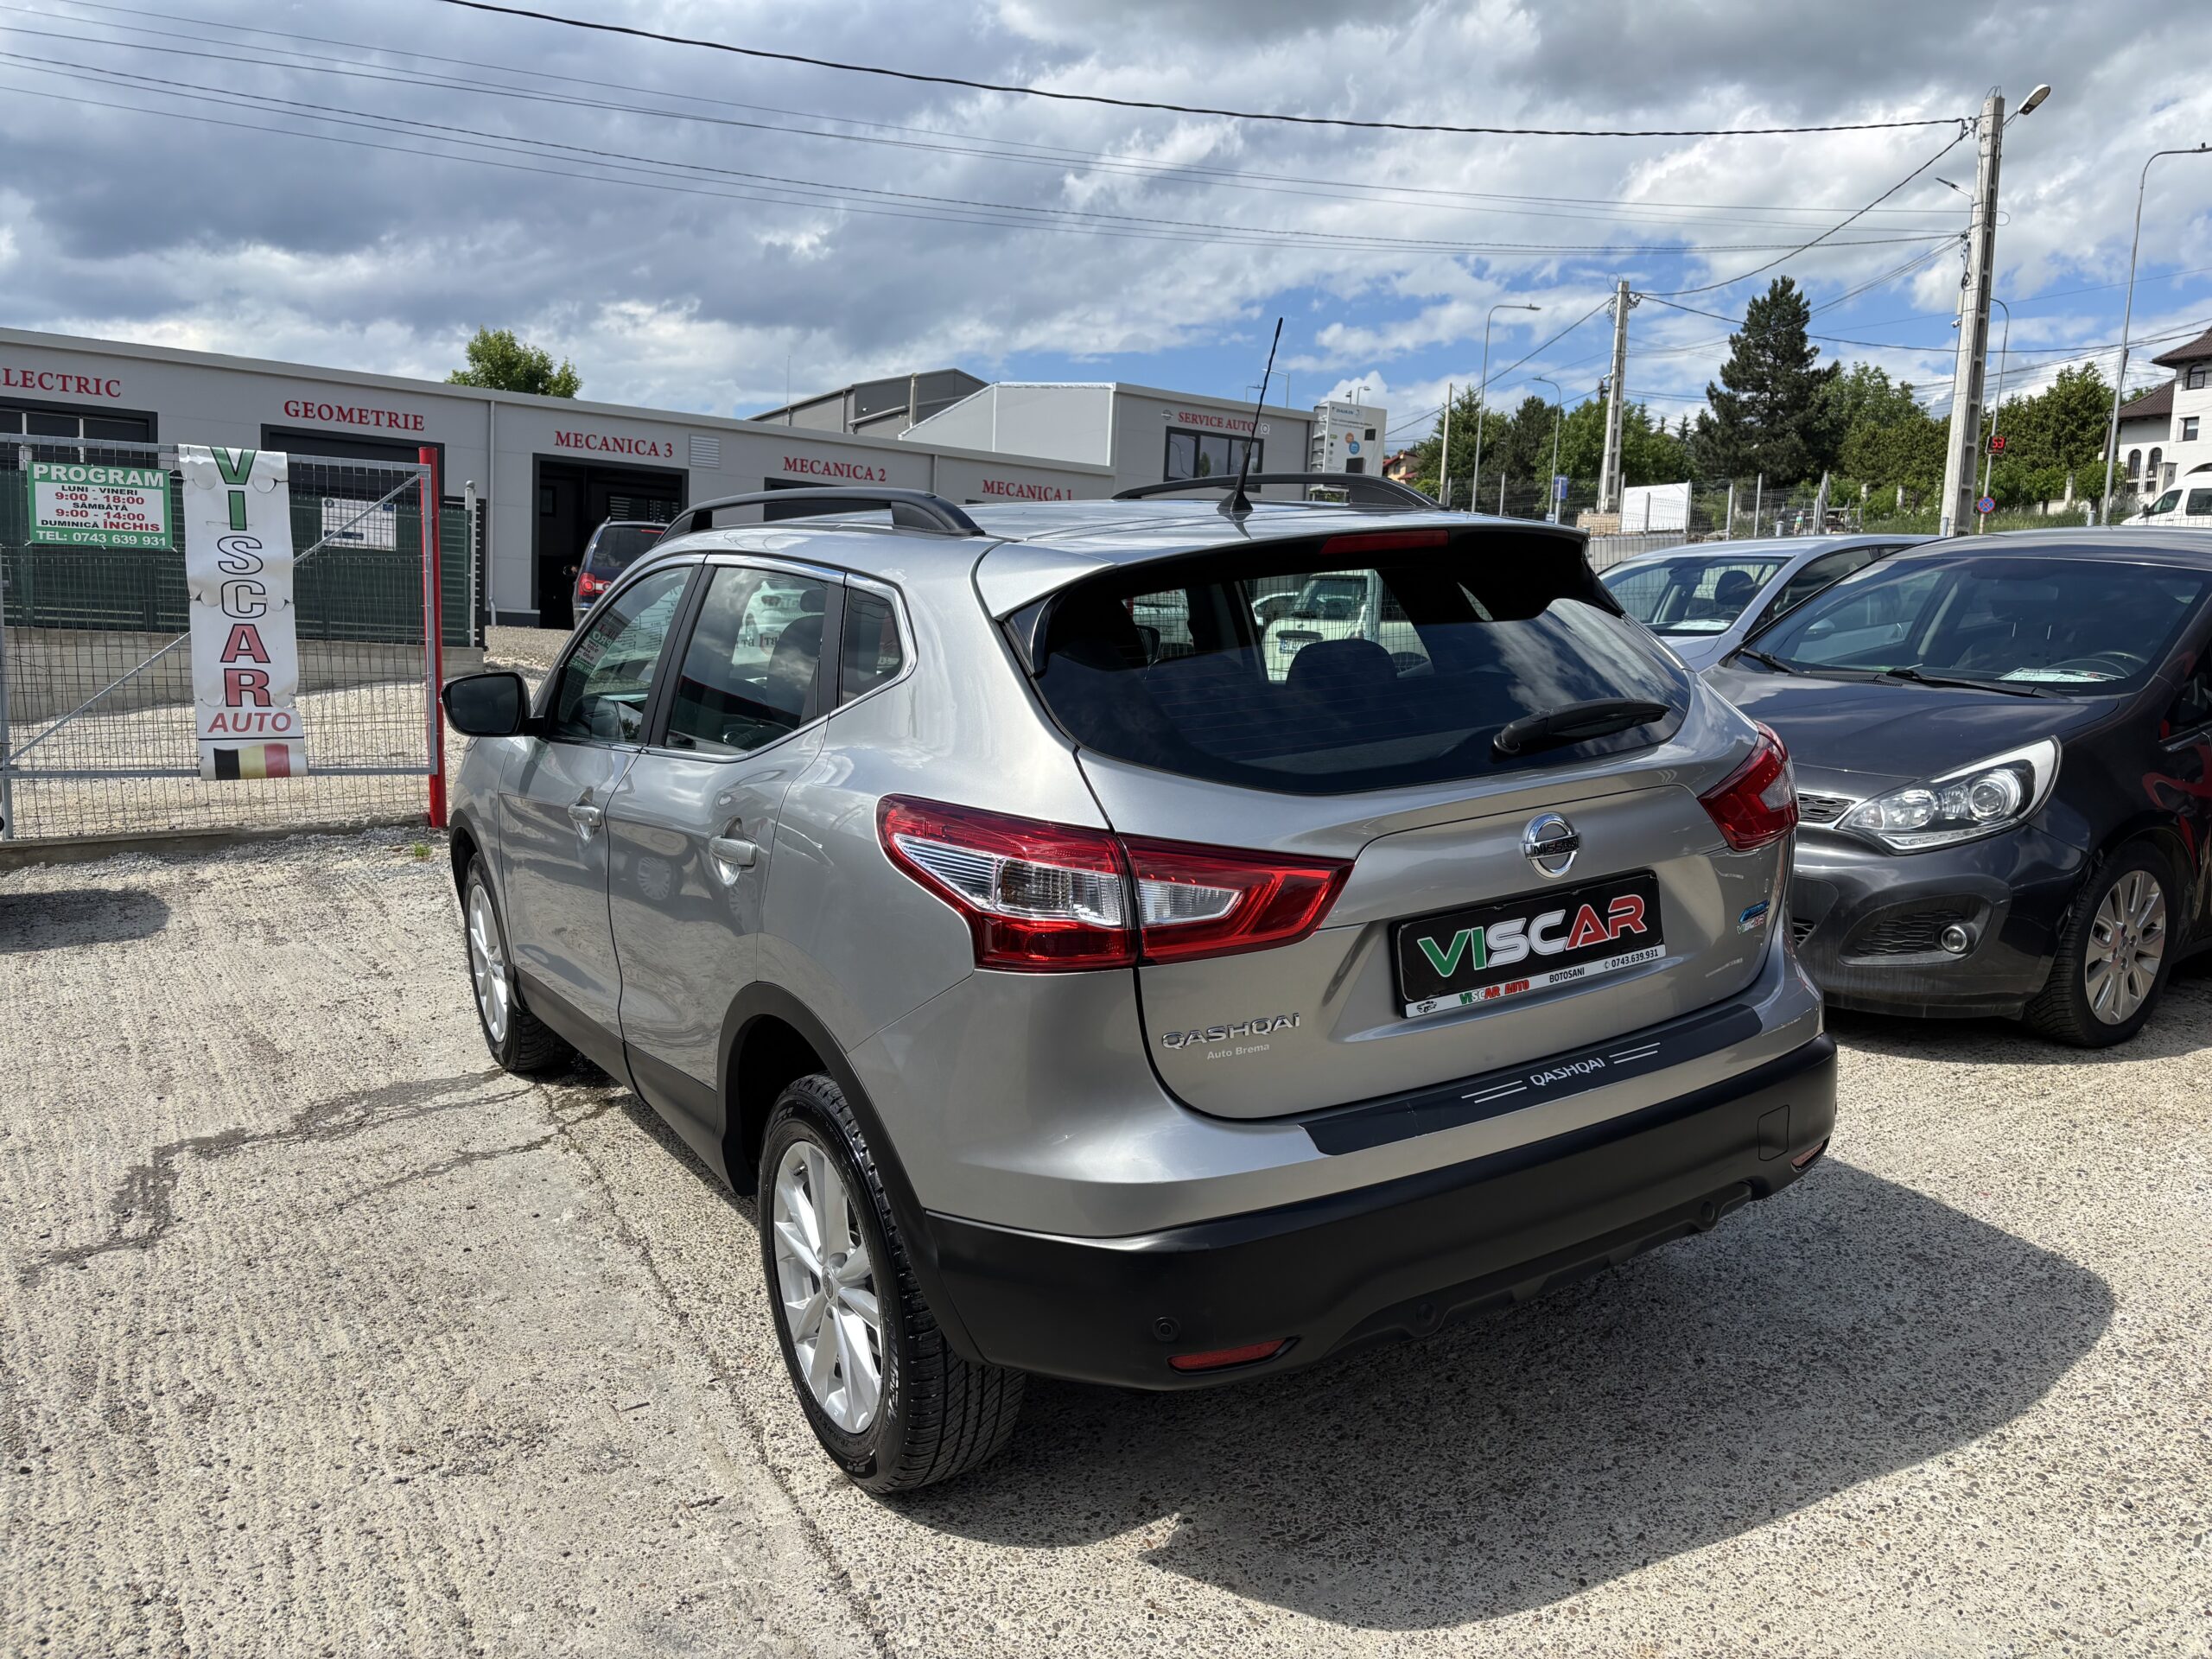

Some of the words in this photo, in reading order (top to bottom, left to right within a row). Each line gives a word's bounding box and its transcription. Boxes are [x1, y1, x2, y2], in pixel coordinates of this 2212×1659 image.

[0, 367, 121, 397] LECTRIC
[284, 400, 425, 431] GEOMETRIE
[1178, 411, 1224, 428] SERVICE
[1225, 418, 1255, 432] AUTO
[554, 430, 660, 457] MECANICA
[664, 442, 673, 458] 3
[33, 463, 164, 487] PROGRAM
[783, 456, 874, 481] MECANICA
[878, 468, 887, 482] 2
[55, 492, 88, 501] 9:00
[104, 495, 144, 505] 18:00
[99, 487, 138, 496] VINERI
[982, 479, 1063, 501] MECANICA
[1067, 489, 1072, 500] 1
[41, 519, 99, 528] DUMINICĂ
[103, 519, 160, 531] ÎNCHIS
[55, 509, 89, 518] 9:00
[104, 512, 145, 521] 14:00
[36, 530, 67, 541] TEL:
[73, 532, 106, 543] 0743
[112, 534, 137, 544] 639
[142, 536, 166, 546] 931
[207, 712, 292, 733] AUTO
[1533, 836, 1578, 855] NISSAN
[1417, 894, 1647, 978] VISCAR
[1459, 986, 1501, 1005] VISCAR
[1504, 979, 1529, 995] AUTO
[1549, 967, 1585, 984] BOTOSANI
[1611, 950, 1659, 968] 0743.639.931
[1161, 1013, 1300, 1050] QASHQAI
[1206, 1048, 1232, 1060] Auto
[1236, 1042, 1270, 1056] Brema
[1530, 1058, 1605, 1087] QASHQAI
